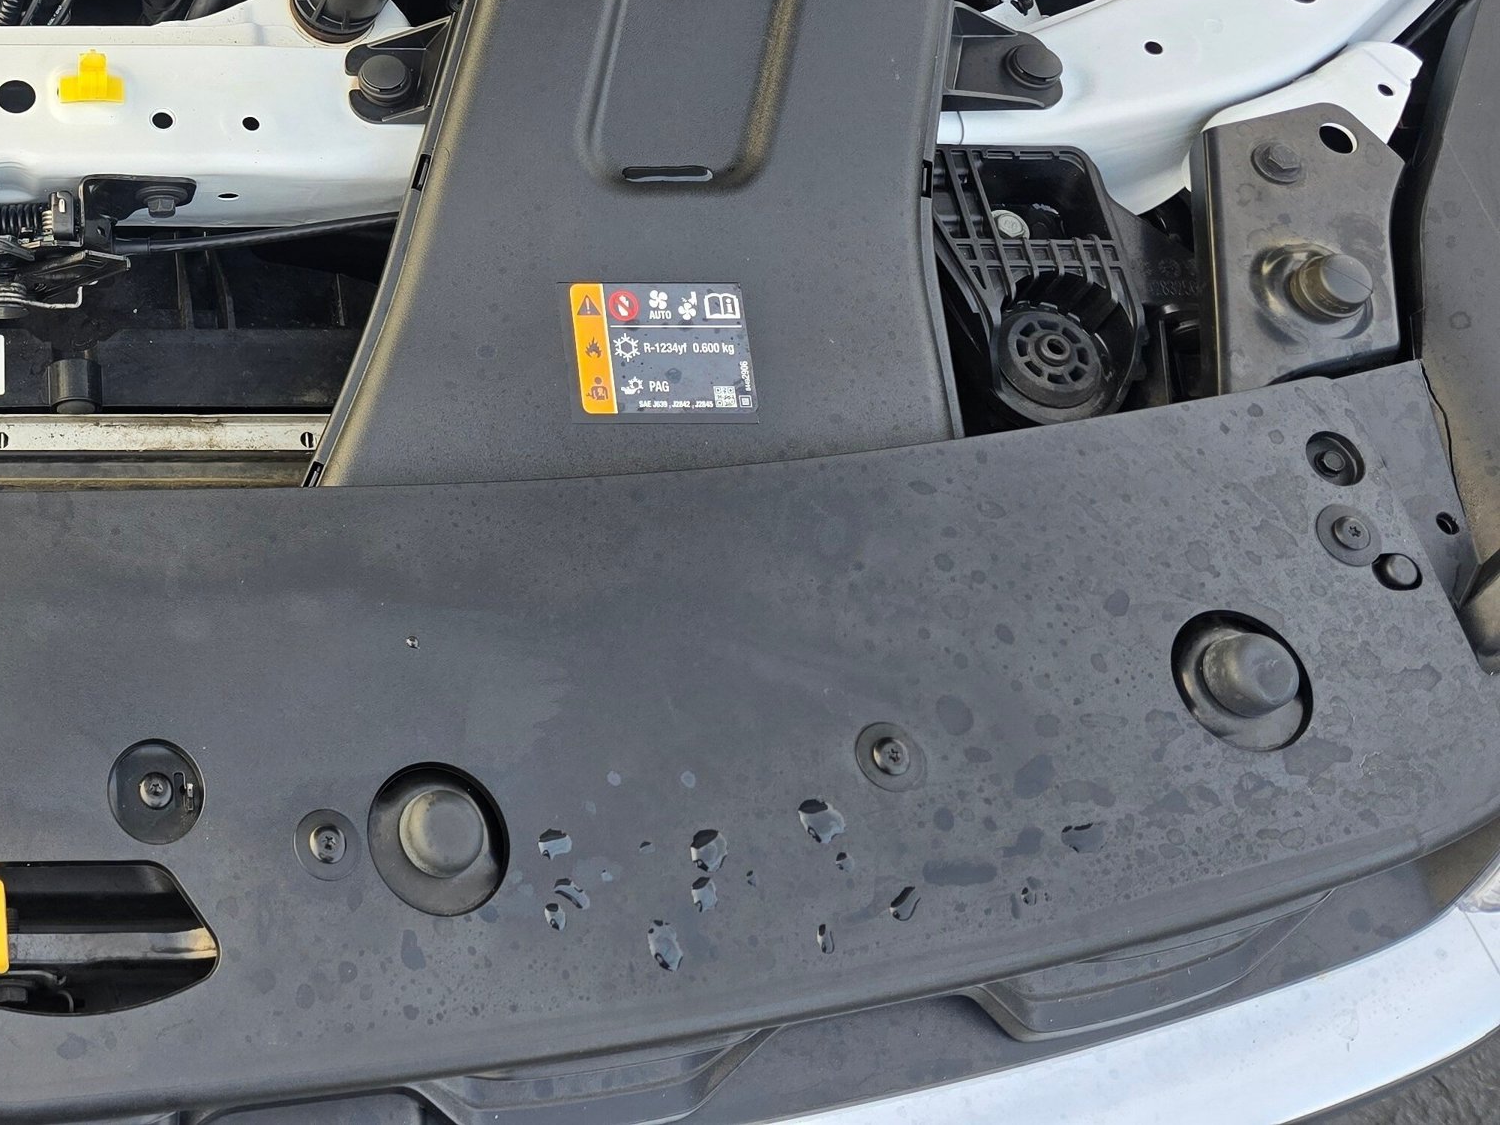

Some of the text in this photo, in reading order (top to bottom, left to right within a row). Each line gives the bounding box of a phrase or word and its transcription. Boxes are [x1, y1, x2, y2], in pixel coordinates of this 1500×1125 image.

[649, 310, 672, 320] AUTO
[644, 343, 735, 355] R-1234yf 0.600 kg
[649, 381, 670, 392] PAG
[638, 400, 652, 408] SAE
